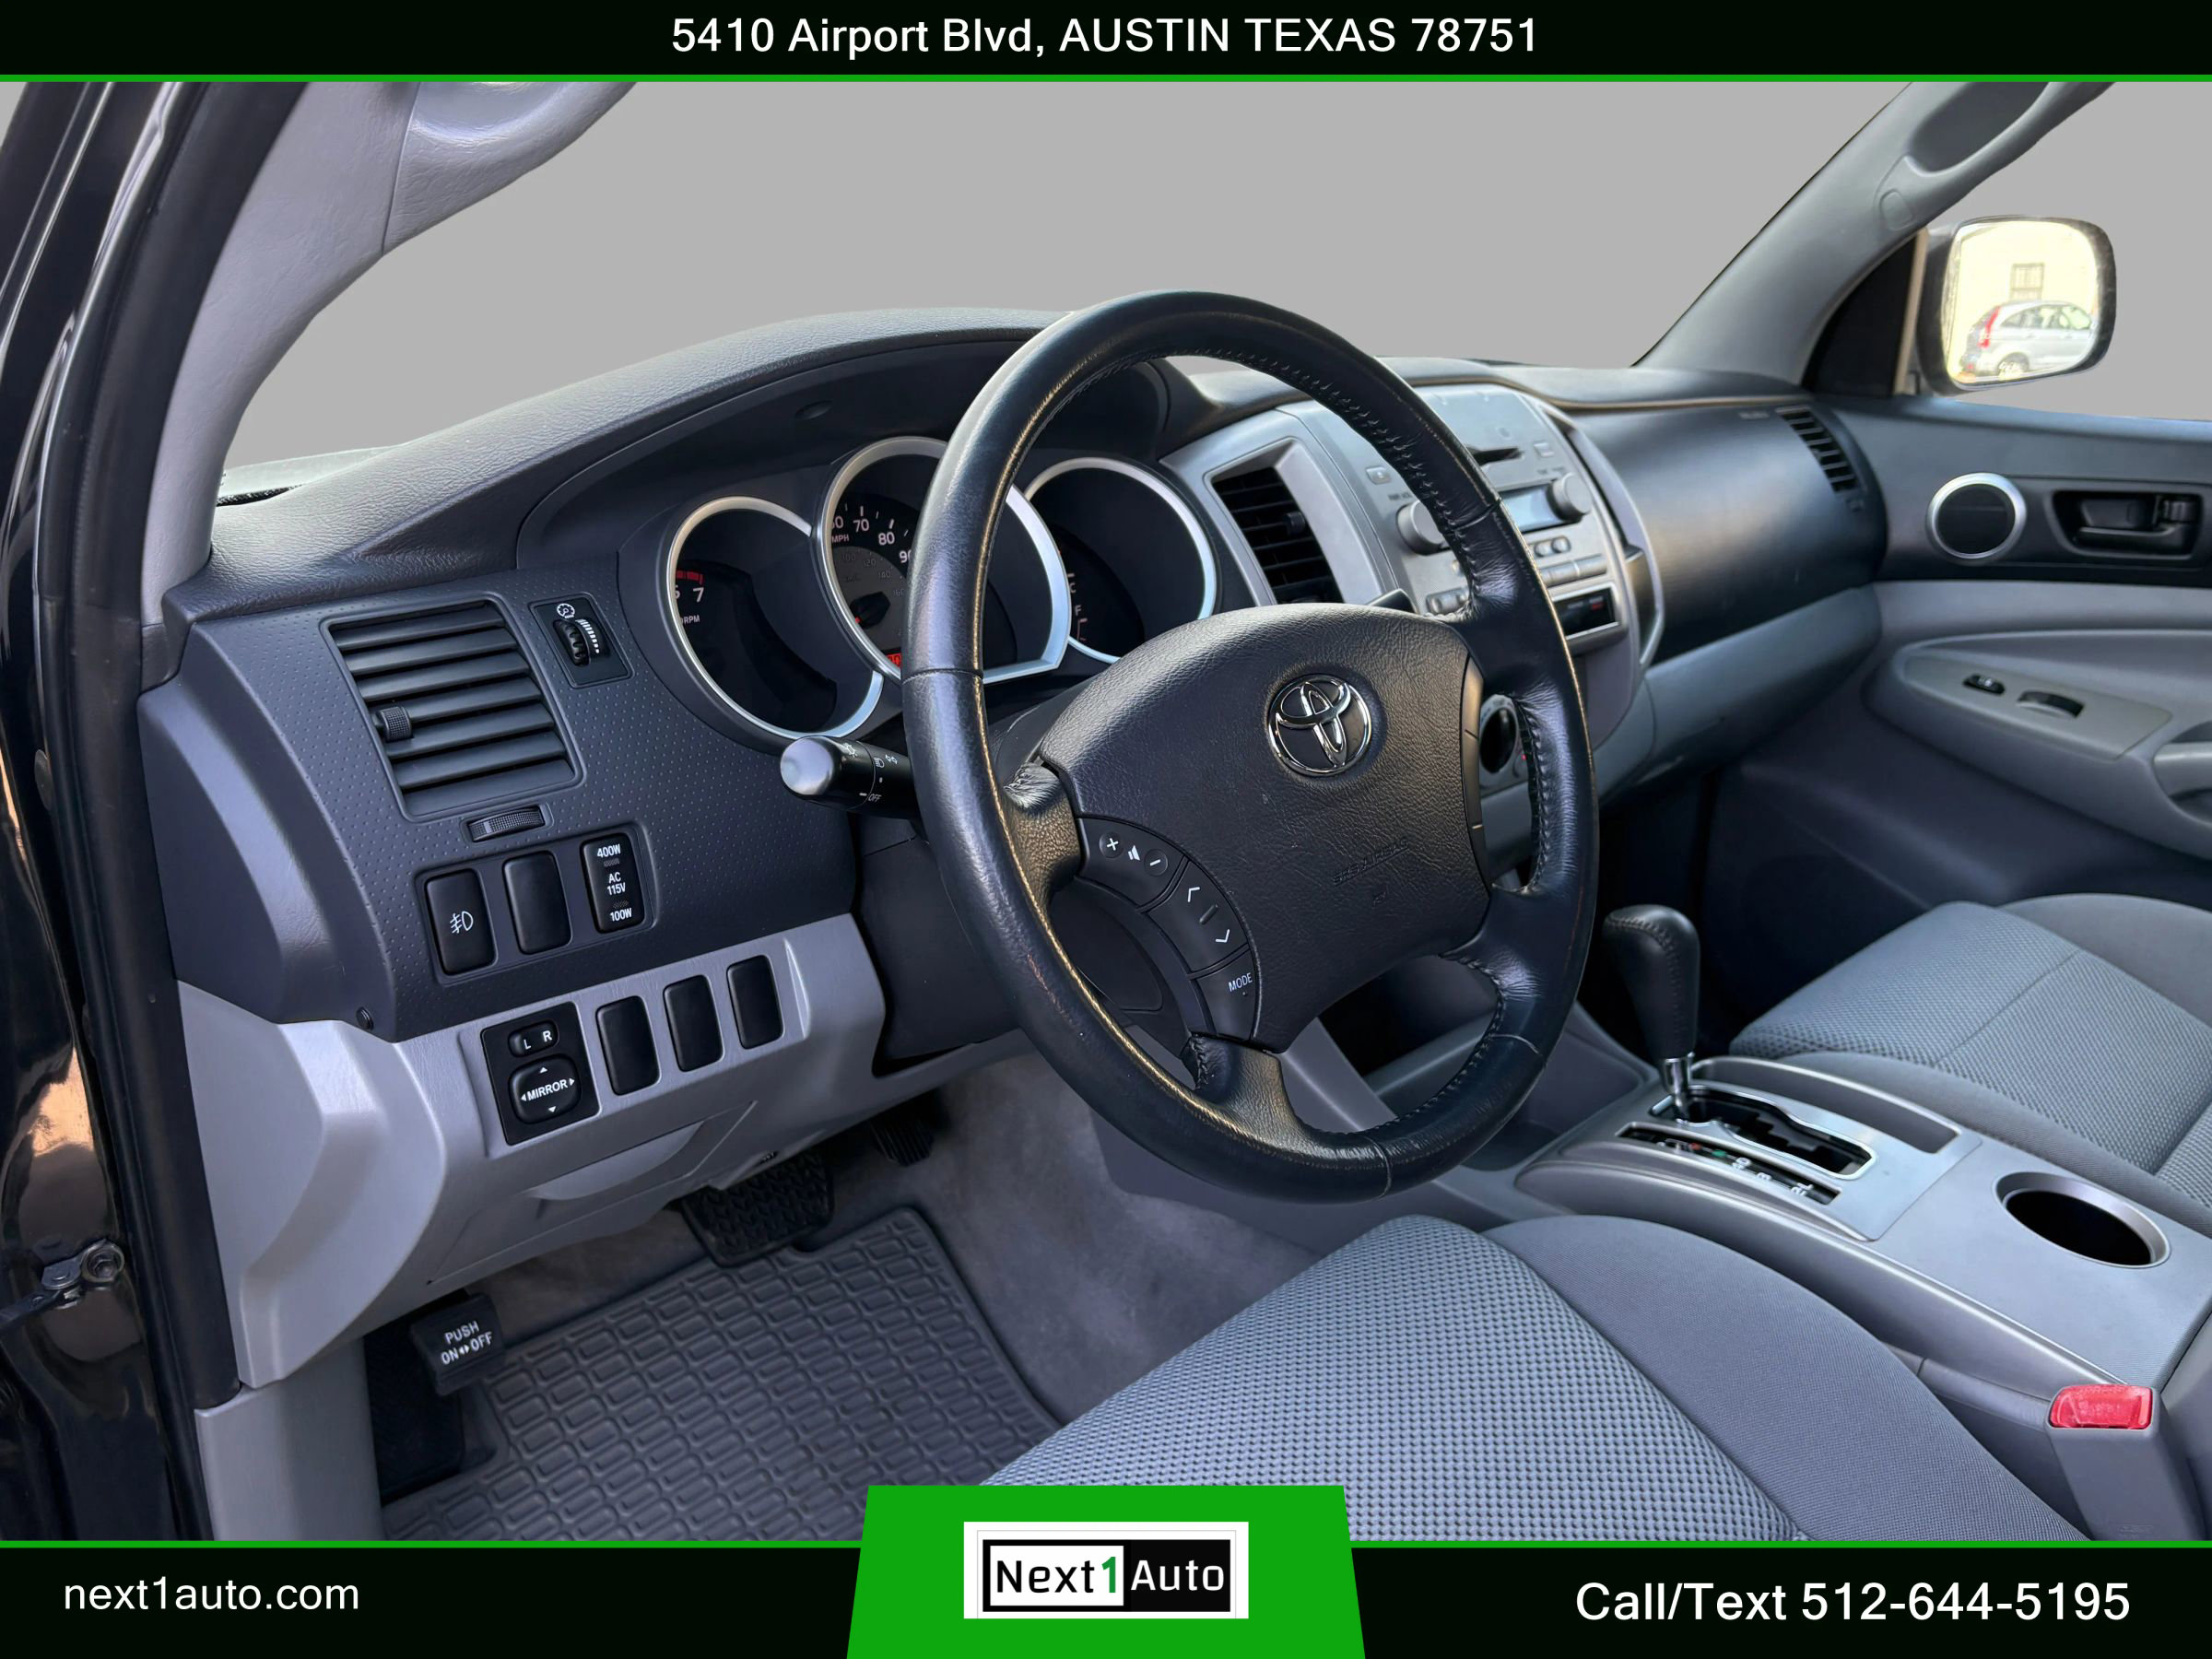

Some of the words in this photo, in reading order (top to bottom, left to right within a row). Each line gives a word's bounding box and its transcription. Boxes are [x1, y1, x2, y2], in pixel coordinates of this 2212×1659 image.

[853, 518, 870, 533] 70
[831, 534, 849, 543] MPH
[878, 531, 896, 546] 80
[692, 586, 704, 603] 7
[1075, 604, 1082, 617] F
[867, 793, 882, 803] OFF
[596, 843, 621, 858] 400W
[608, 871, 622, 884] AC
[606, 882, 627, 897] 115V
[609, 907, 632, 923] 100W
[1228, 972, 1253, 993] MODE
[524, 1039, 532, 1050] L
[542, 1030, 553, 1042] R
[526, 1078, 569, 1101] MIRROR
[444, 1320, 479, 1345] PUSH
[441, 1347, 459, 1365] ON
[469, 1331, 492, 1352] OFF
